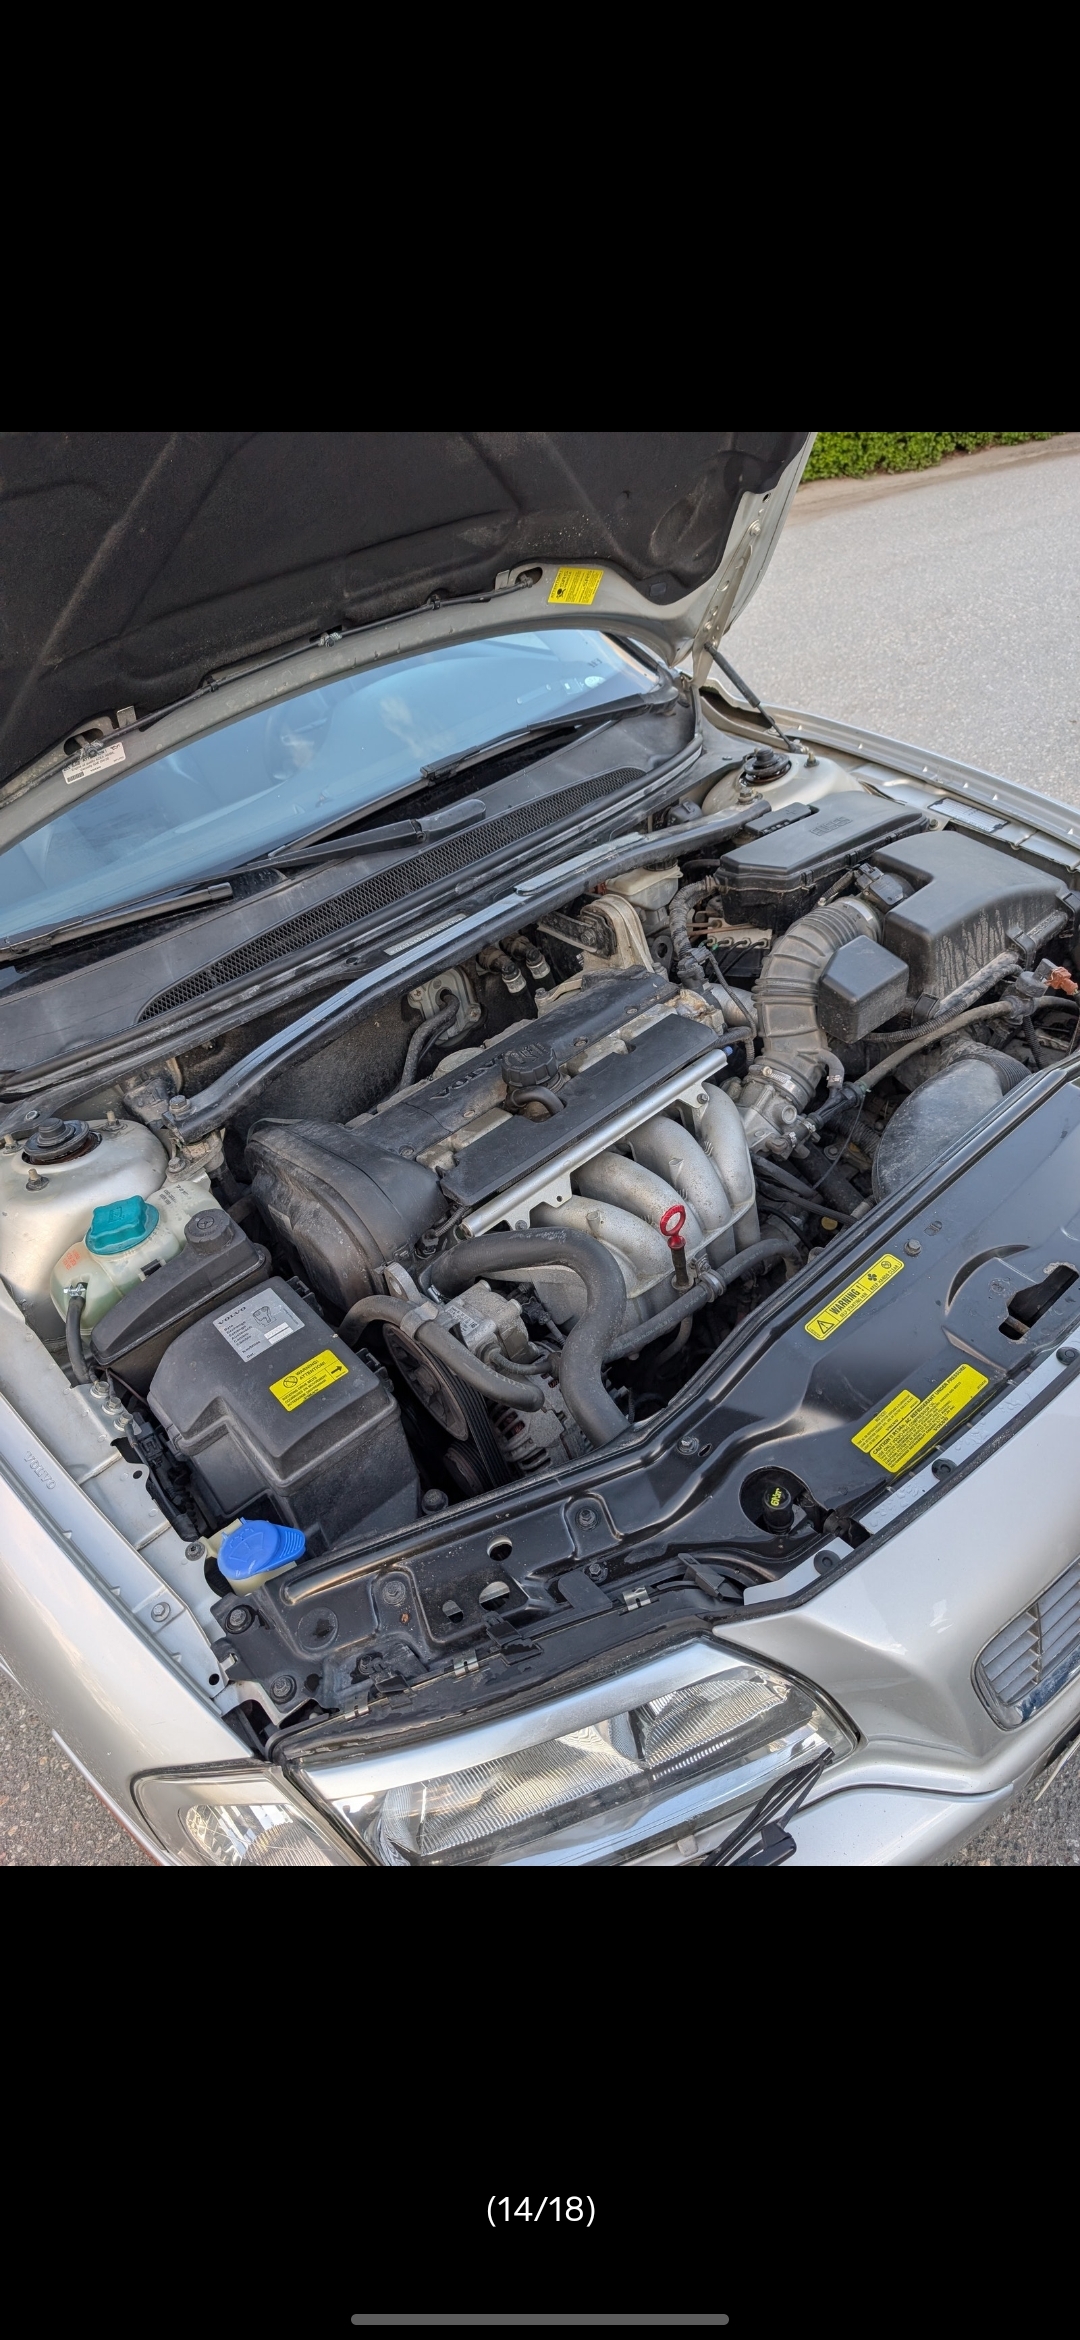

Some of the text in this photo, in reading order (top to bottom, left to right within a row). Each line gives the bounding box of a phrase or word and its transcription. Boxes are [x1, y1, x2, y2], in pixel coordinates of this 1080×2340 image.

[829, 1288, 861, 1315] WARNING
[218, 1307, 246, 1325] VOLVO
[296, 1359, 319, 1376] WARNING!
[299, 1361, 326, 1380] ATTENTION!
[872, 1438, 890, 1454] CAUTION
[910, 1394, 936, 1419] REFRIGERANT
[934, 1382, 948, 1395] UNDER
[947, 1365, 966, 1384] PRESSURE
[933, 1417, 949, 1431] VOLVO
[24, 1451, 56, 1490] VOLVO
